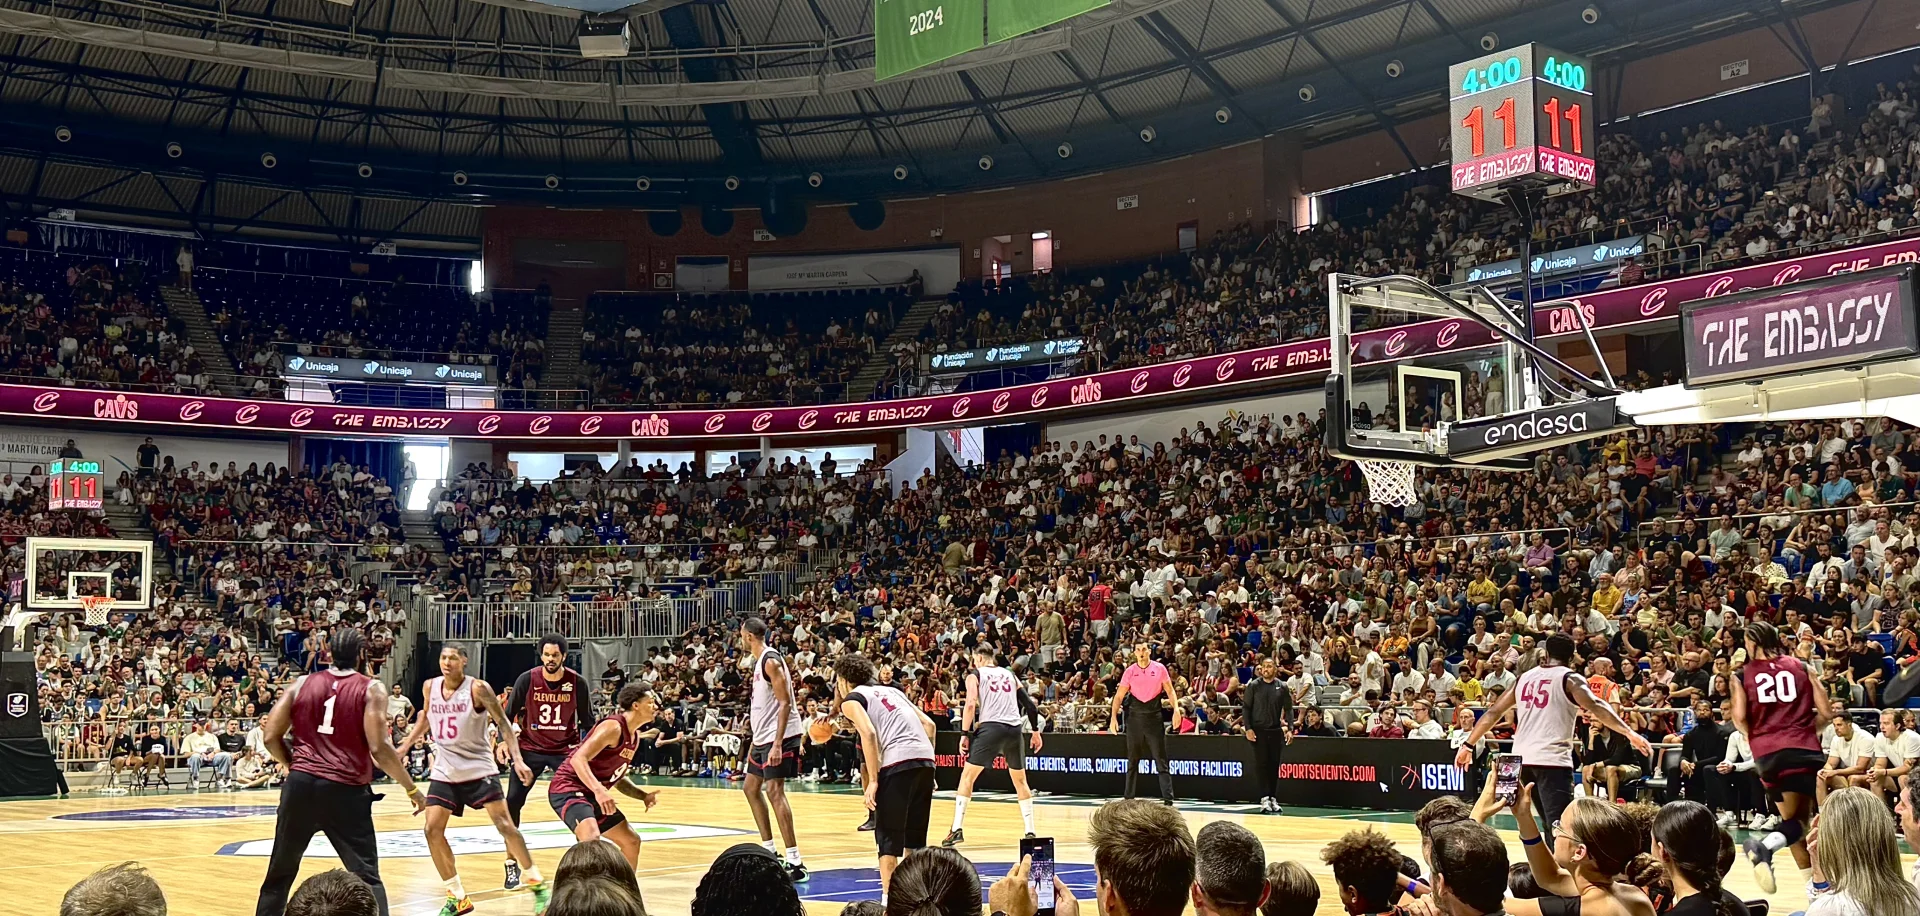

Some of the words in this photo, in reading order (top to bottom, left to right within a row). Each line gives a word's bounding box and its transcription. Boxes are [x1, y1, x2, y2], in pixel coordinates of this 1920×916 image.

[909, 6, 944, 36] 2024
[1462, 56, 1521, 93] 4:00
[1544, 57, 1585, 90] 4:00
[1723, 61, 1747, 71] SECTOR
[1730, 69, 1740, 77] A2
[1462, 97, 1516, 157] 11
[1543, 97, 1582, 154] 11
[1454, 166, 1474, 188] THE
[1480, 151, 1533, 181] EMBASSY
[1540, 152, 1554, 173] THE
[1558, 157, 1594, 182] EMBASSY
[1609, 245, 1642, 258] Unicaja
[1545, 257, 1577, 270] Unicaja
[1702, 316, 1749, 367] THE
[1764, 292, 1893, 358] EMBASSY
[944, 352, 974, 361] Fundación
[999, 345, 1030, 355] Fundación
[999, 352, 1022, 361] Unicaja
[305, 362, 339, 372] Unicaja
[379, 366, 413, 376] Unicaja
[1251, 354, 1279, 372] THE
[451, 369, 482, 379] Unicaja
[1070, 377, 1102, 405] CAVS
[94, 394, 138, 419] CAVS
[834, 410, 861, 424] THE
[867, 404, 932, 422] EMBASSY
[332, 413, 364, 427] THE
[371, 416, 452, 429] EMBASSY
[631, 413, 669, 436] CAVS
[1484, 411, 1587, 445] endesa
[7, 443, 39, 455] MARTÍN
[69, 461, 99, 473] 4:00
[69, 476, 96, 498] 11
[1520, 680, 1552, 709] 45
[1754, 670, 1797, 703] 20
[533, 692, 571, 702] CLEVELAND
[317, 695, 337, 735] 1
[431, 704, 467, 714] CLEVELAND
[539, 704, 562, 725] 31
[438, 716, 458, 740] 15
[1025, 757, 1038, 771] FOR
[1039, 757, 1068, 773] EVENTS,
[1069, 758, 1094, 774] CLUBS,
[1169, 760, 1199, 776] SPORTS
[1200, 760, 1242, 777] FACILITIES
